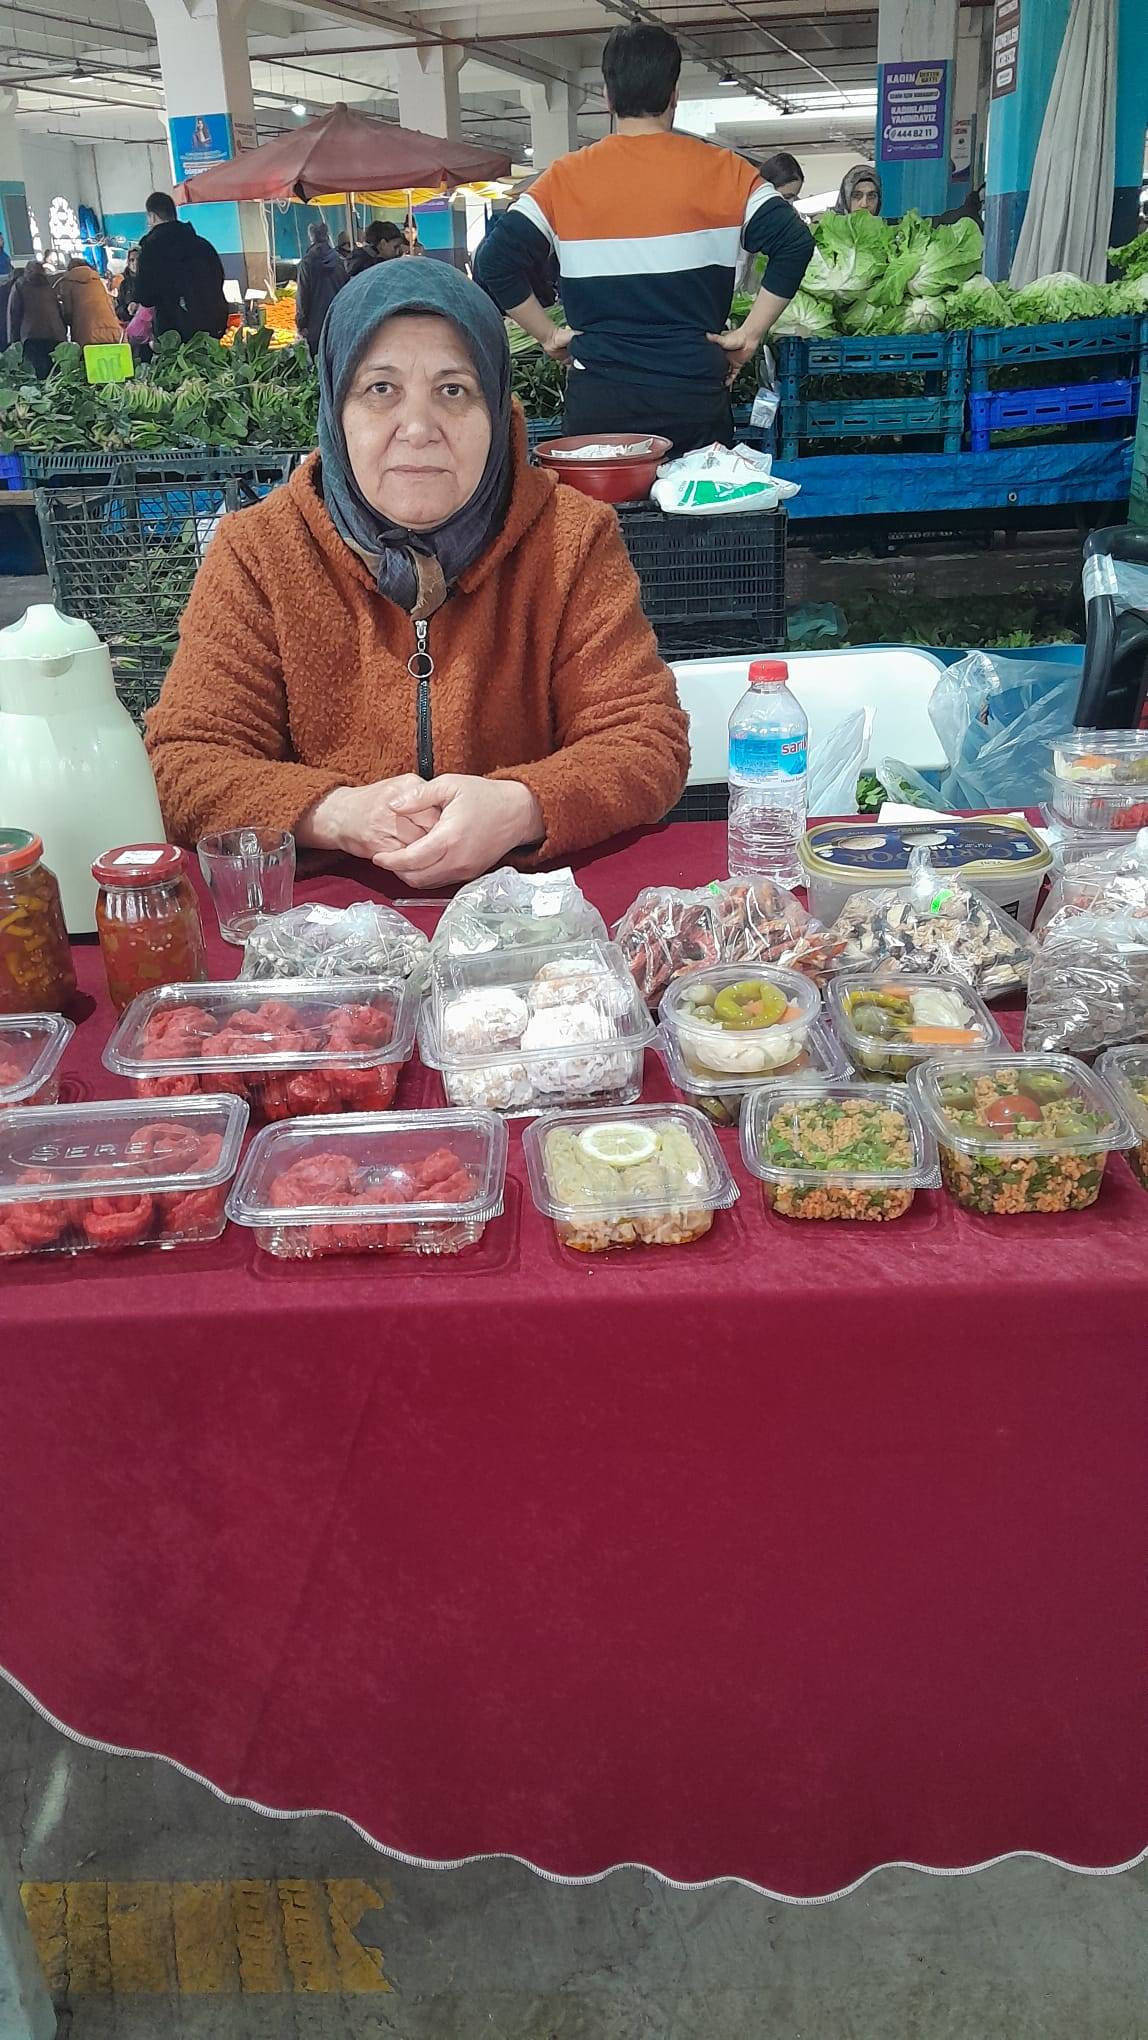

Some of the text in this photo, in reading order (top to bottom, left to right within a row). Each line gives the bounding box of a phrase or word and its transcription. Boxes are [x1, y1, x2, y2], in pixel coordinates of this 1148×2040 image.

[887, 73, 915, 84] KADIN
[896, 128, 932, 137] 444 82 11
